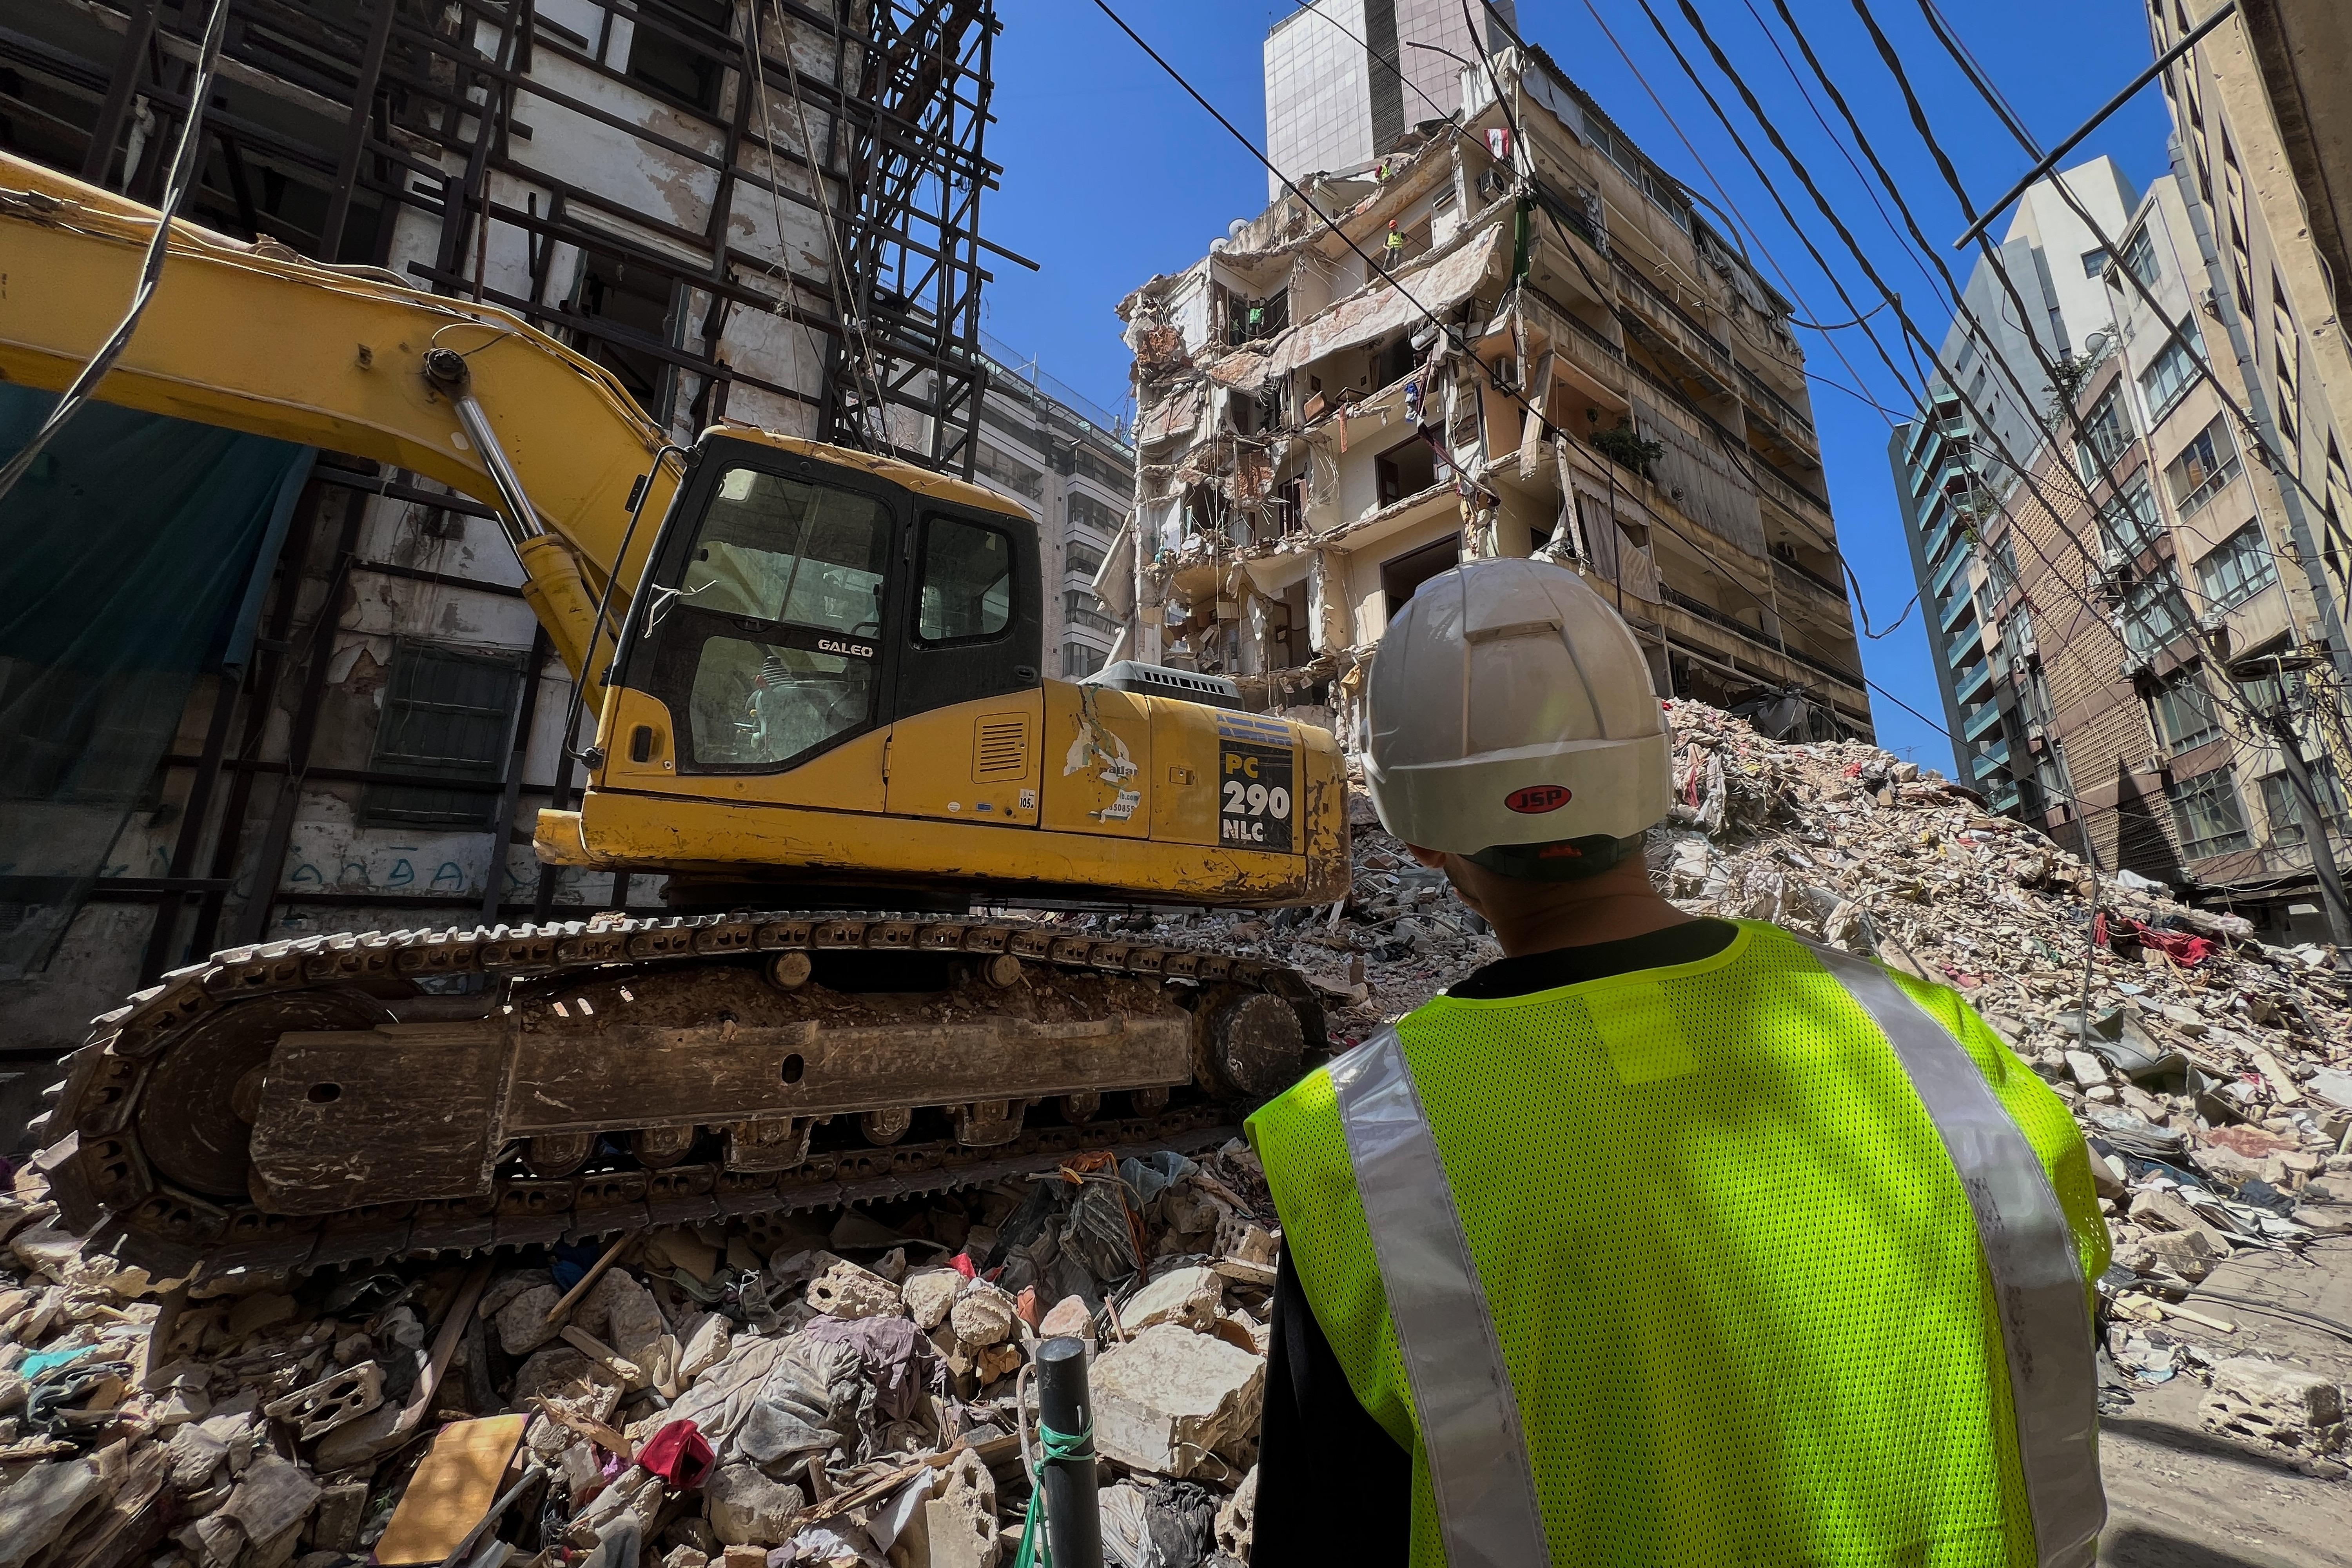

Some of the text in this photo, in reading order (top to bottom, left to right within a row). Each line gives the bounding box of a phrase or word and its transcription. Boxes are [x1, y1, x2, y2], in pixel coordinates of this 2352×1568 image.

[818, 639, 873, 657] GALEO
[1225, 753, 1259, 778] PC
[1223, 780, 1290, 819] 290
[1516, 789, 1562, 808] JSP
[1223, 819, 1263, 842] NLC
